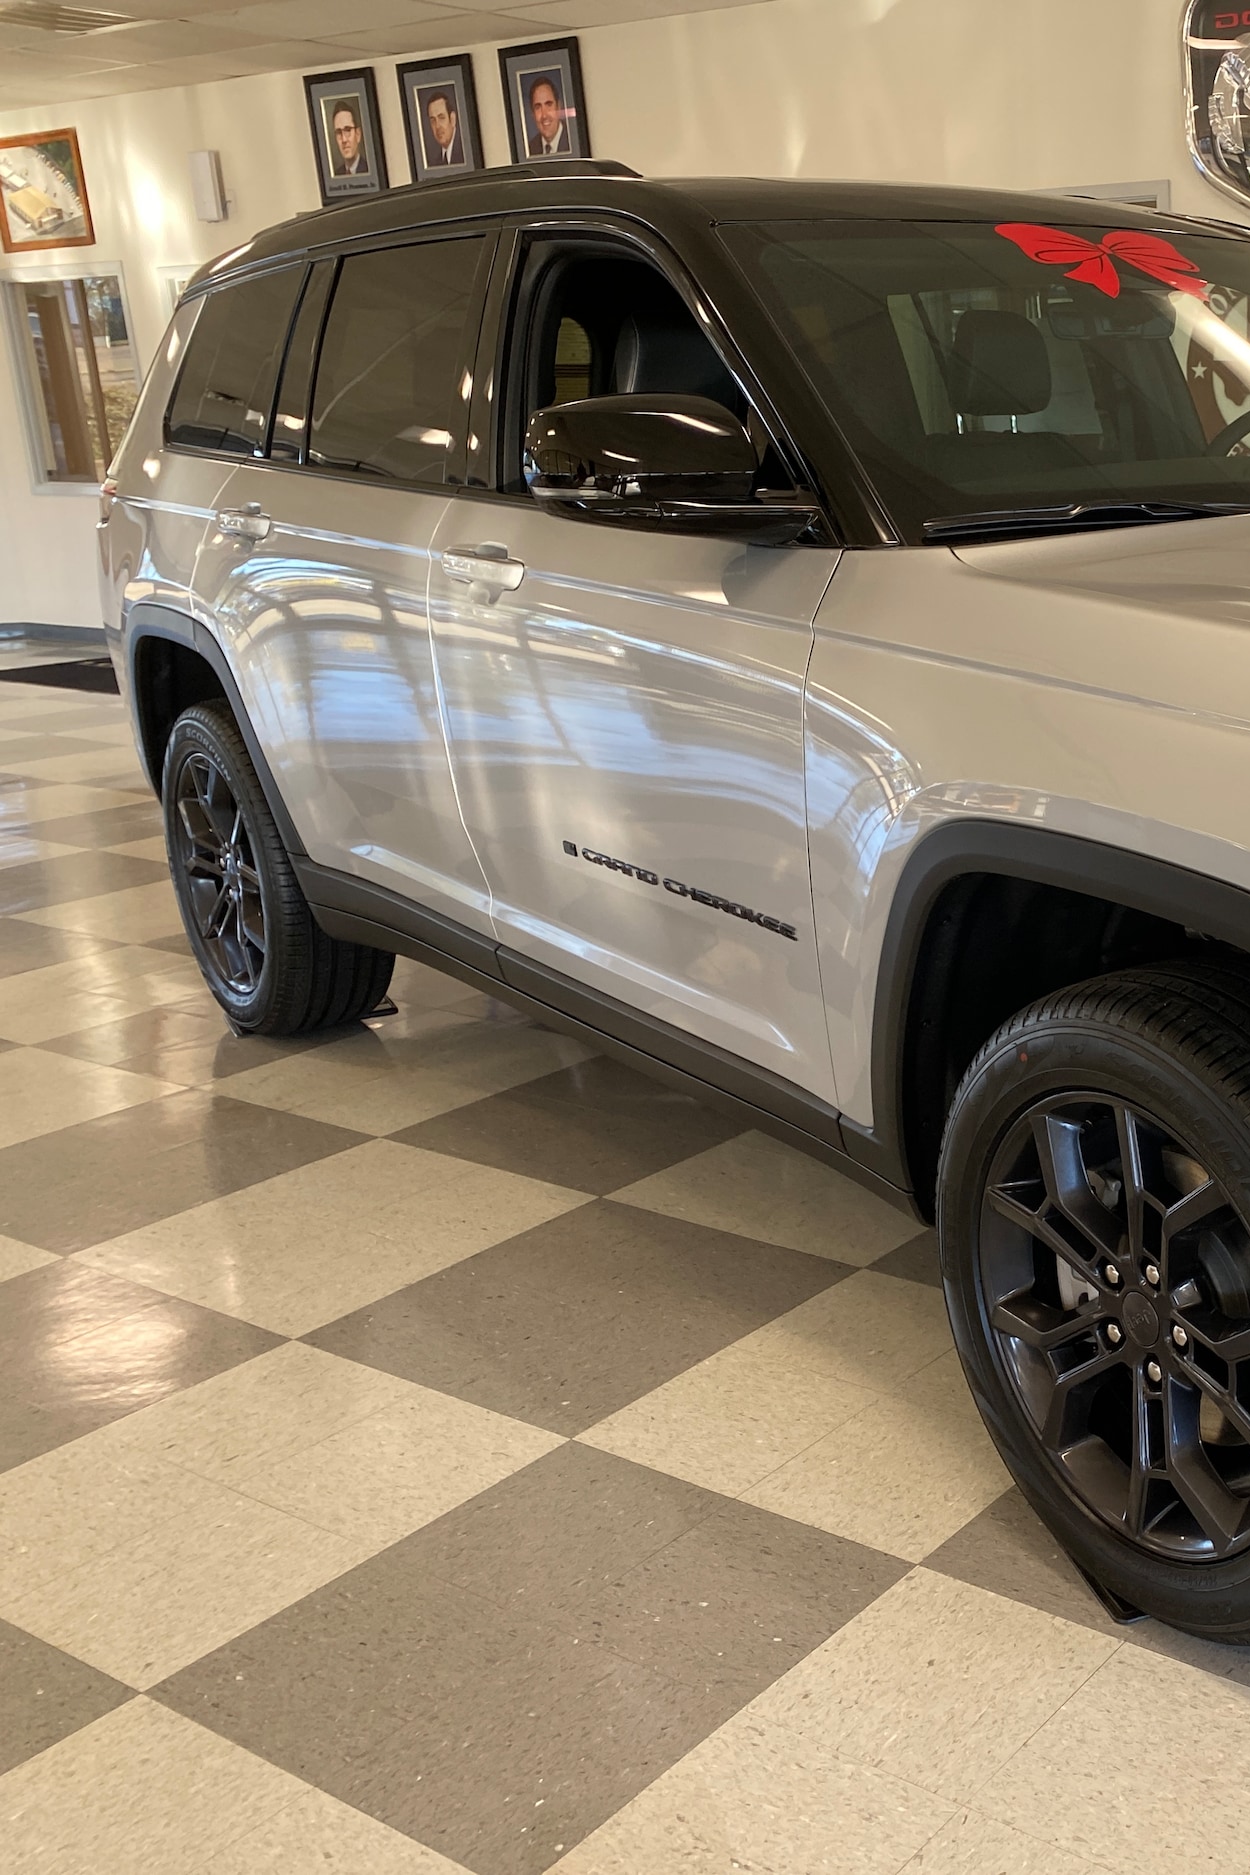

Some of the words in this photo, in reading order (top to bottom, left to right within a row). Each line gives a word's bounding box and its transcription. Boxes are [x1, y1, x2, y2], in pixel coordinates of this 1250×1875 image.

[185, 728, 232, 782] SCORPION
[582, 848, 659, 885] GRAND
[663, 878, 798, 941] CHEROKEE
[1127, 1309, 1151, 1329] Jeep
